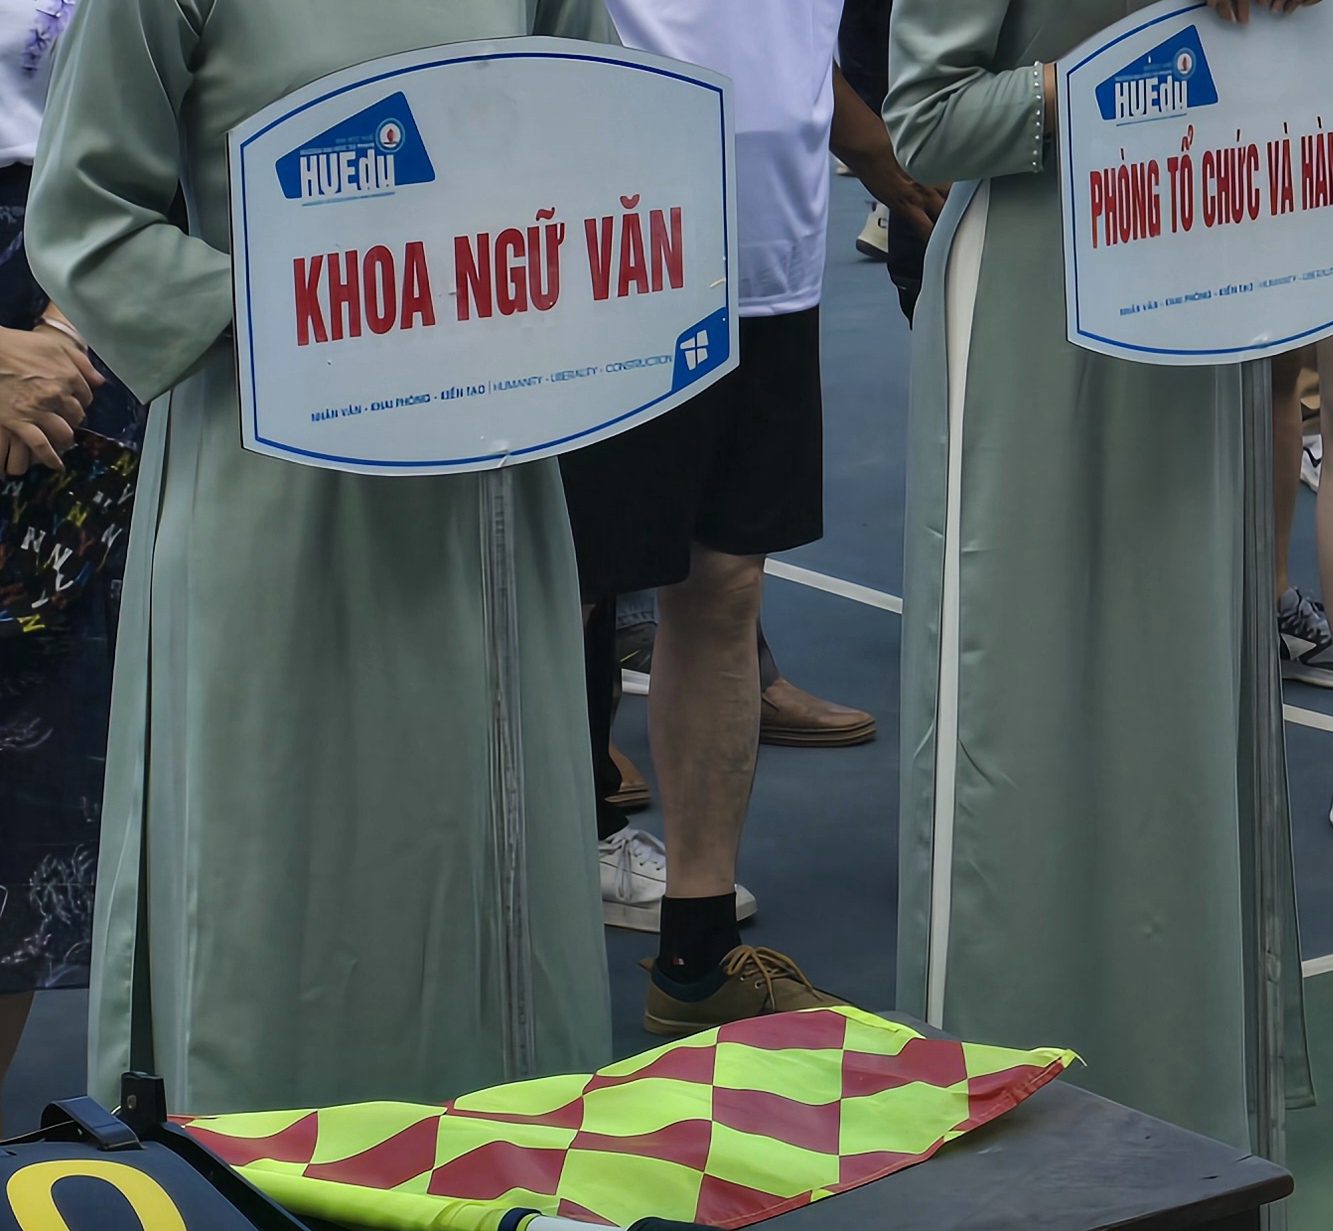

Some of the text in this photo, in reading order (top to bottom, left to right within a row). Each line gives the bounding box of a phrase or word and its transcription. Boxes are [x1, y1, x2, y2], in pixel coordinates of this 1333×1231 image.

[1115, 75, 1188, 119] HUEdu
[299, 148, 397, 199] HUEdu
[1089, 147, 1161, 249] PHÒNG
[1166, 124, 1195, 234] TỔ
[1201, 128, 1260, 229] CHỨC
[1266, 121, 1295, 216] VÀ
[292, 193, 685, 347] KHOA NGỮ VĂN
